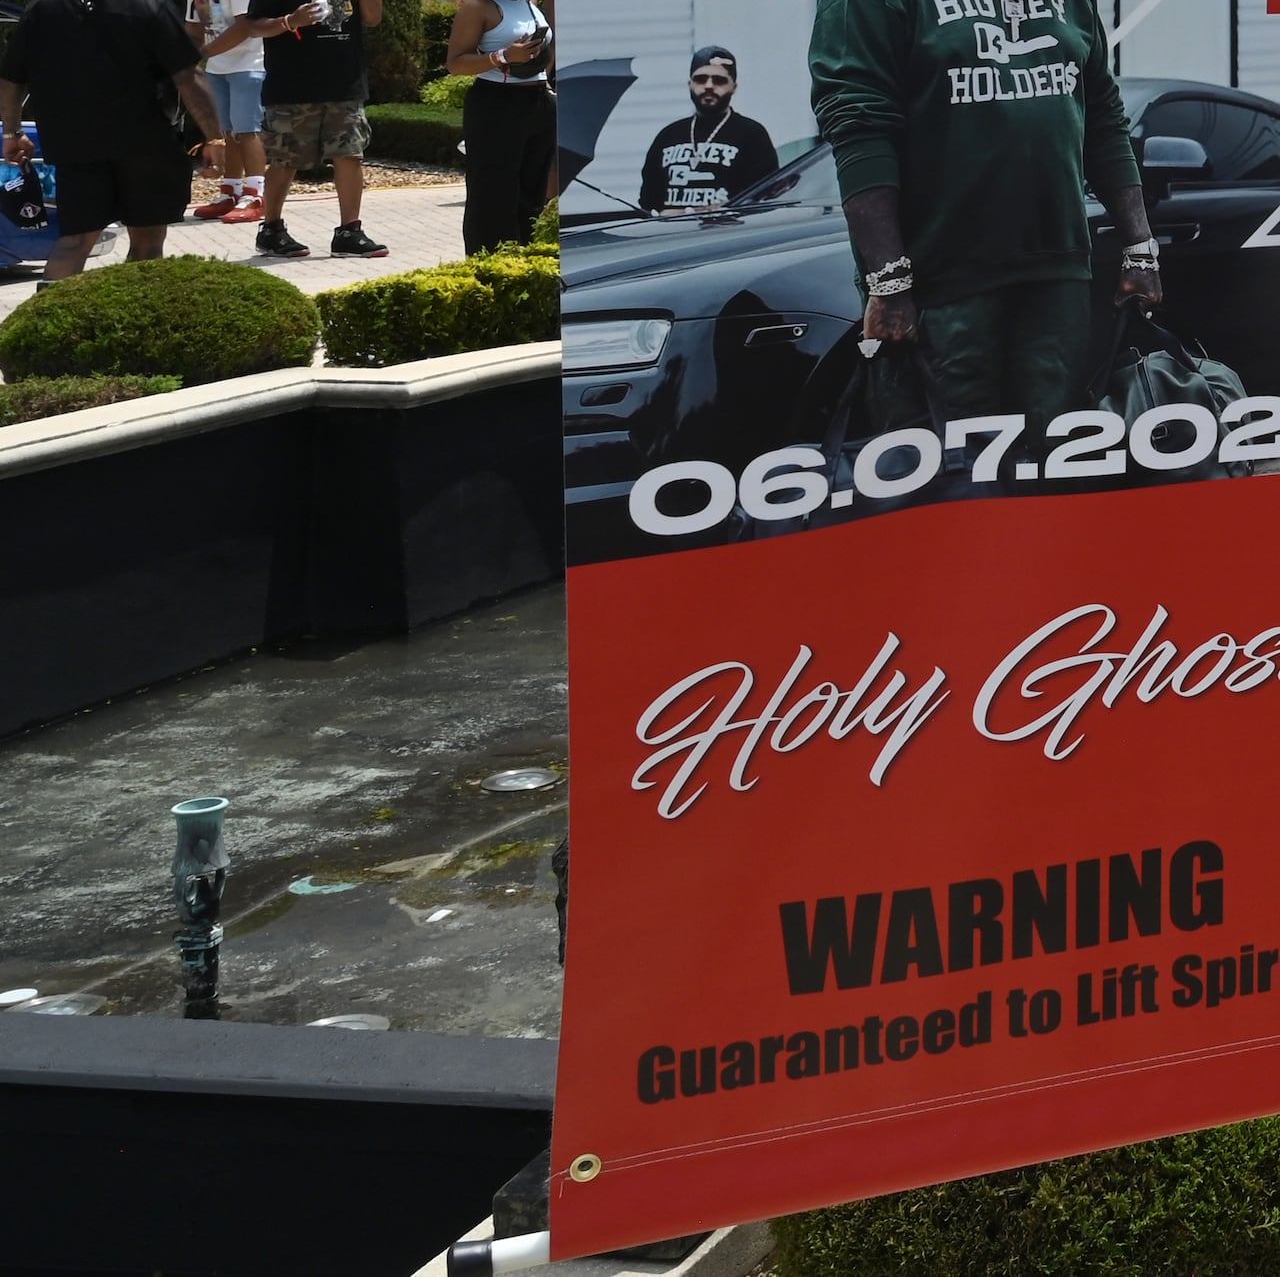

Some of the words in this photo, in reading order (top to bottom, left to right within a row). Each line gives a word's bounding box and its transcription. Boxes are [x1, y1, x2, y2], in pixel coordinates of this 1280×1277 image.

[947, 61, 1081, 105] HOLDER$
[631, 631, 952, 820] Holy
[779, 839, 1226, 996] WARNING
[637, 990, 993, 1105] Guaranteed
[1006, 986, 1063, 1038] to
[1077, 963, 1160, 1027] Lift
